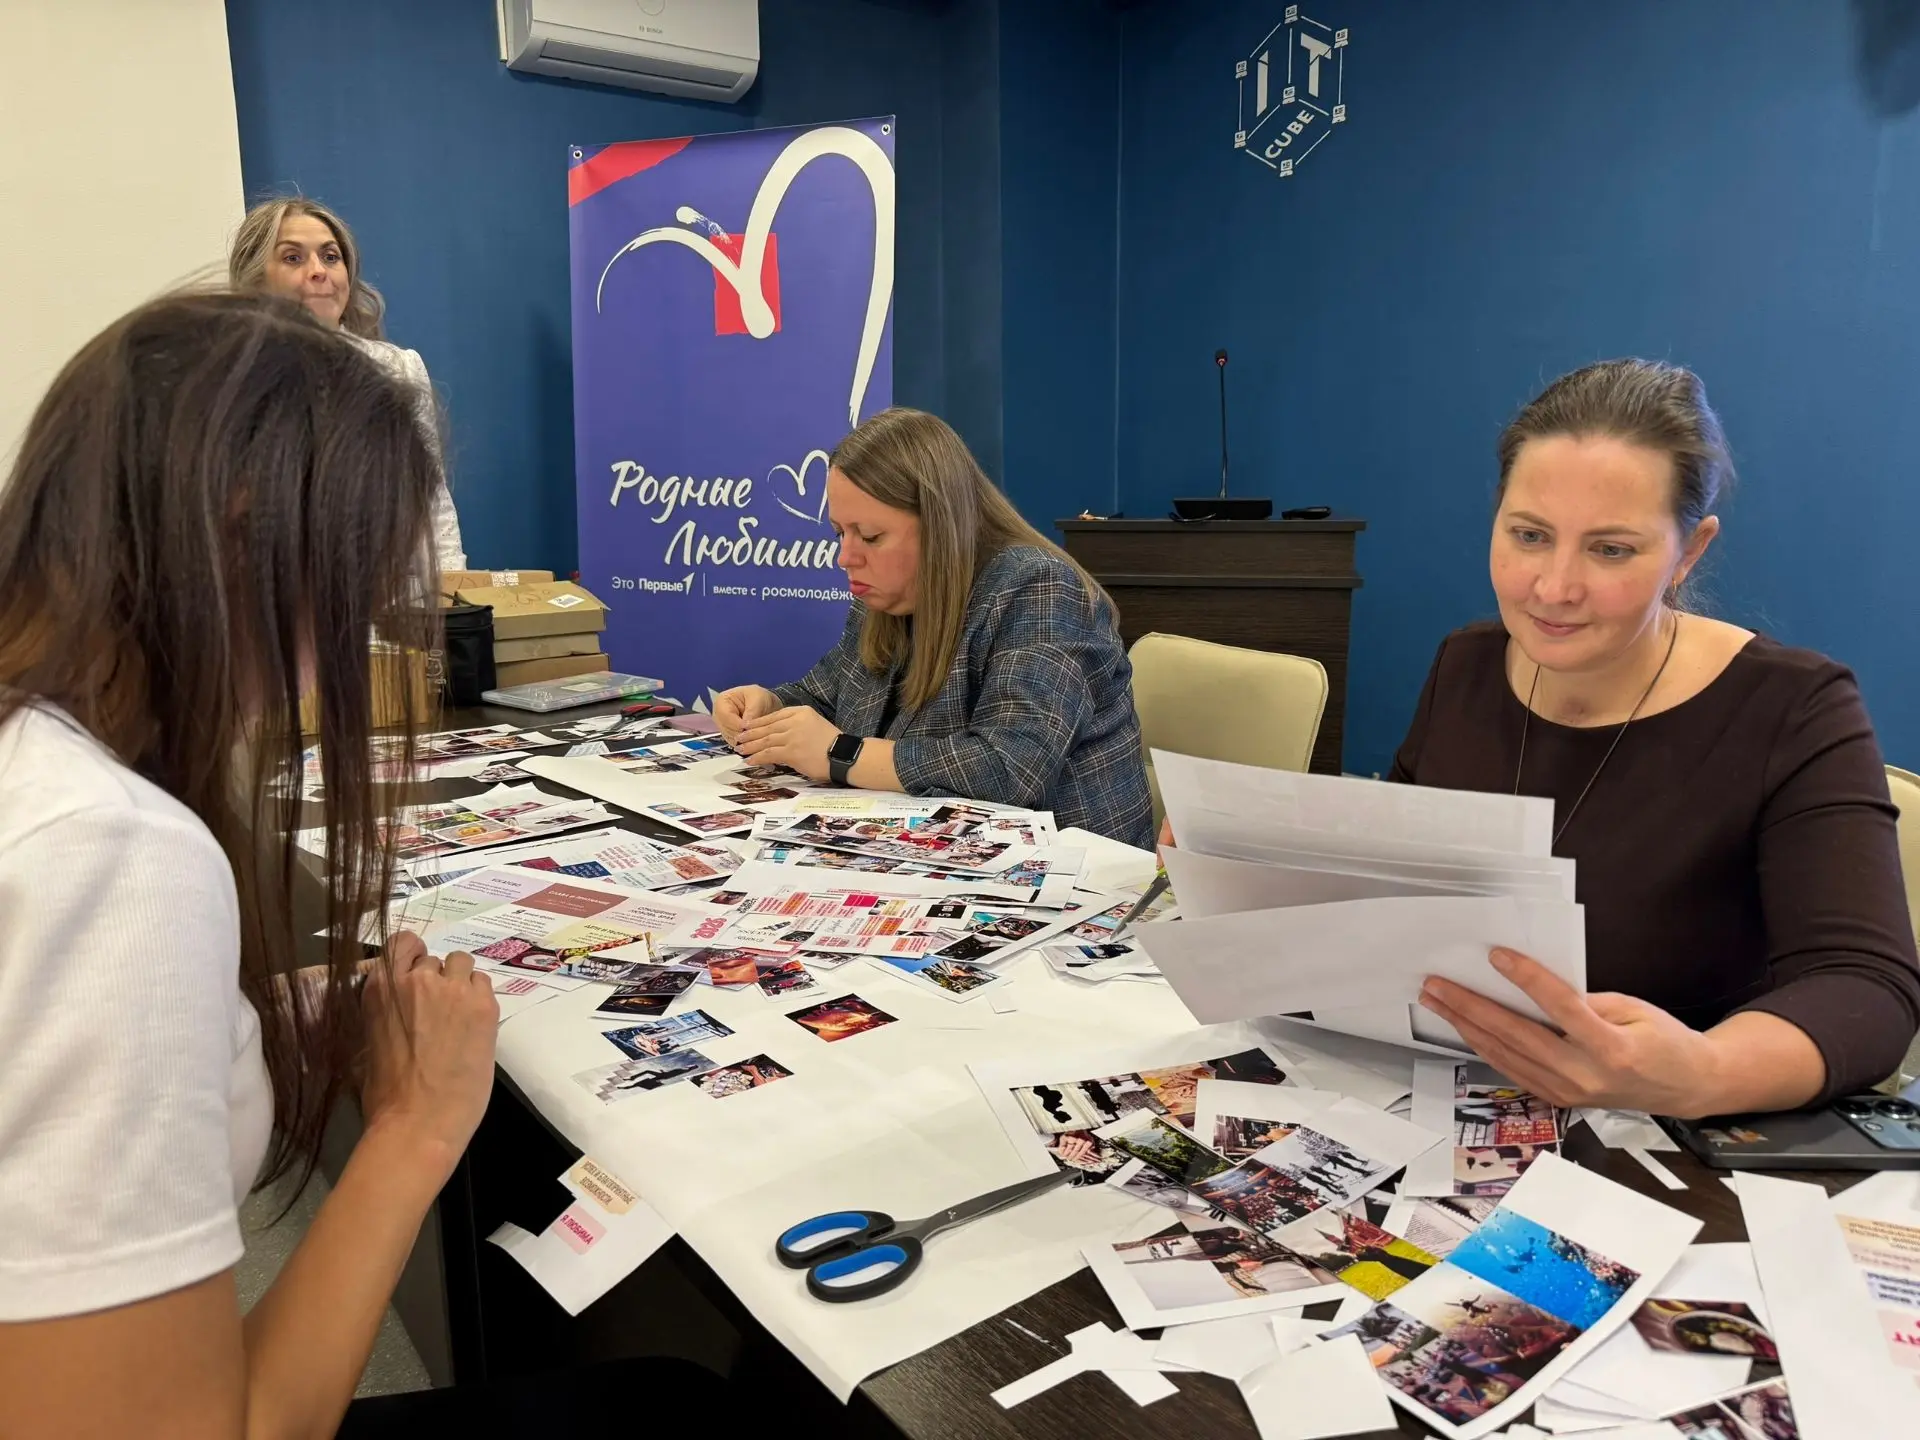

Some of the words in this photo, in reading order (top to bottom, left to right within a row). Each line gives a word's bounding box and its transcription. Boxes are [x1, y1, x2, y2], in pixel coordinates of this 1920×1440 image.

[1256, 32, 1332, 117] IT
[1264, 109, 1315, 159] CUBE
[610, 460, 752, 523] Родные
[664, 517, 846, 569] Любимы
[612, 576, 634, 590] Это
[713, 585, 747, 596] вместе
[751, 587, 757, 596] с
